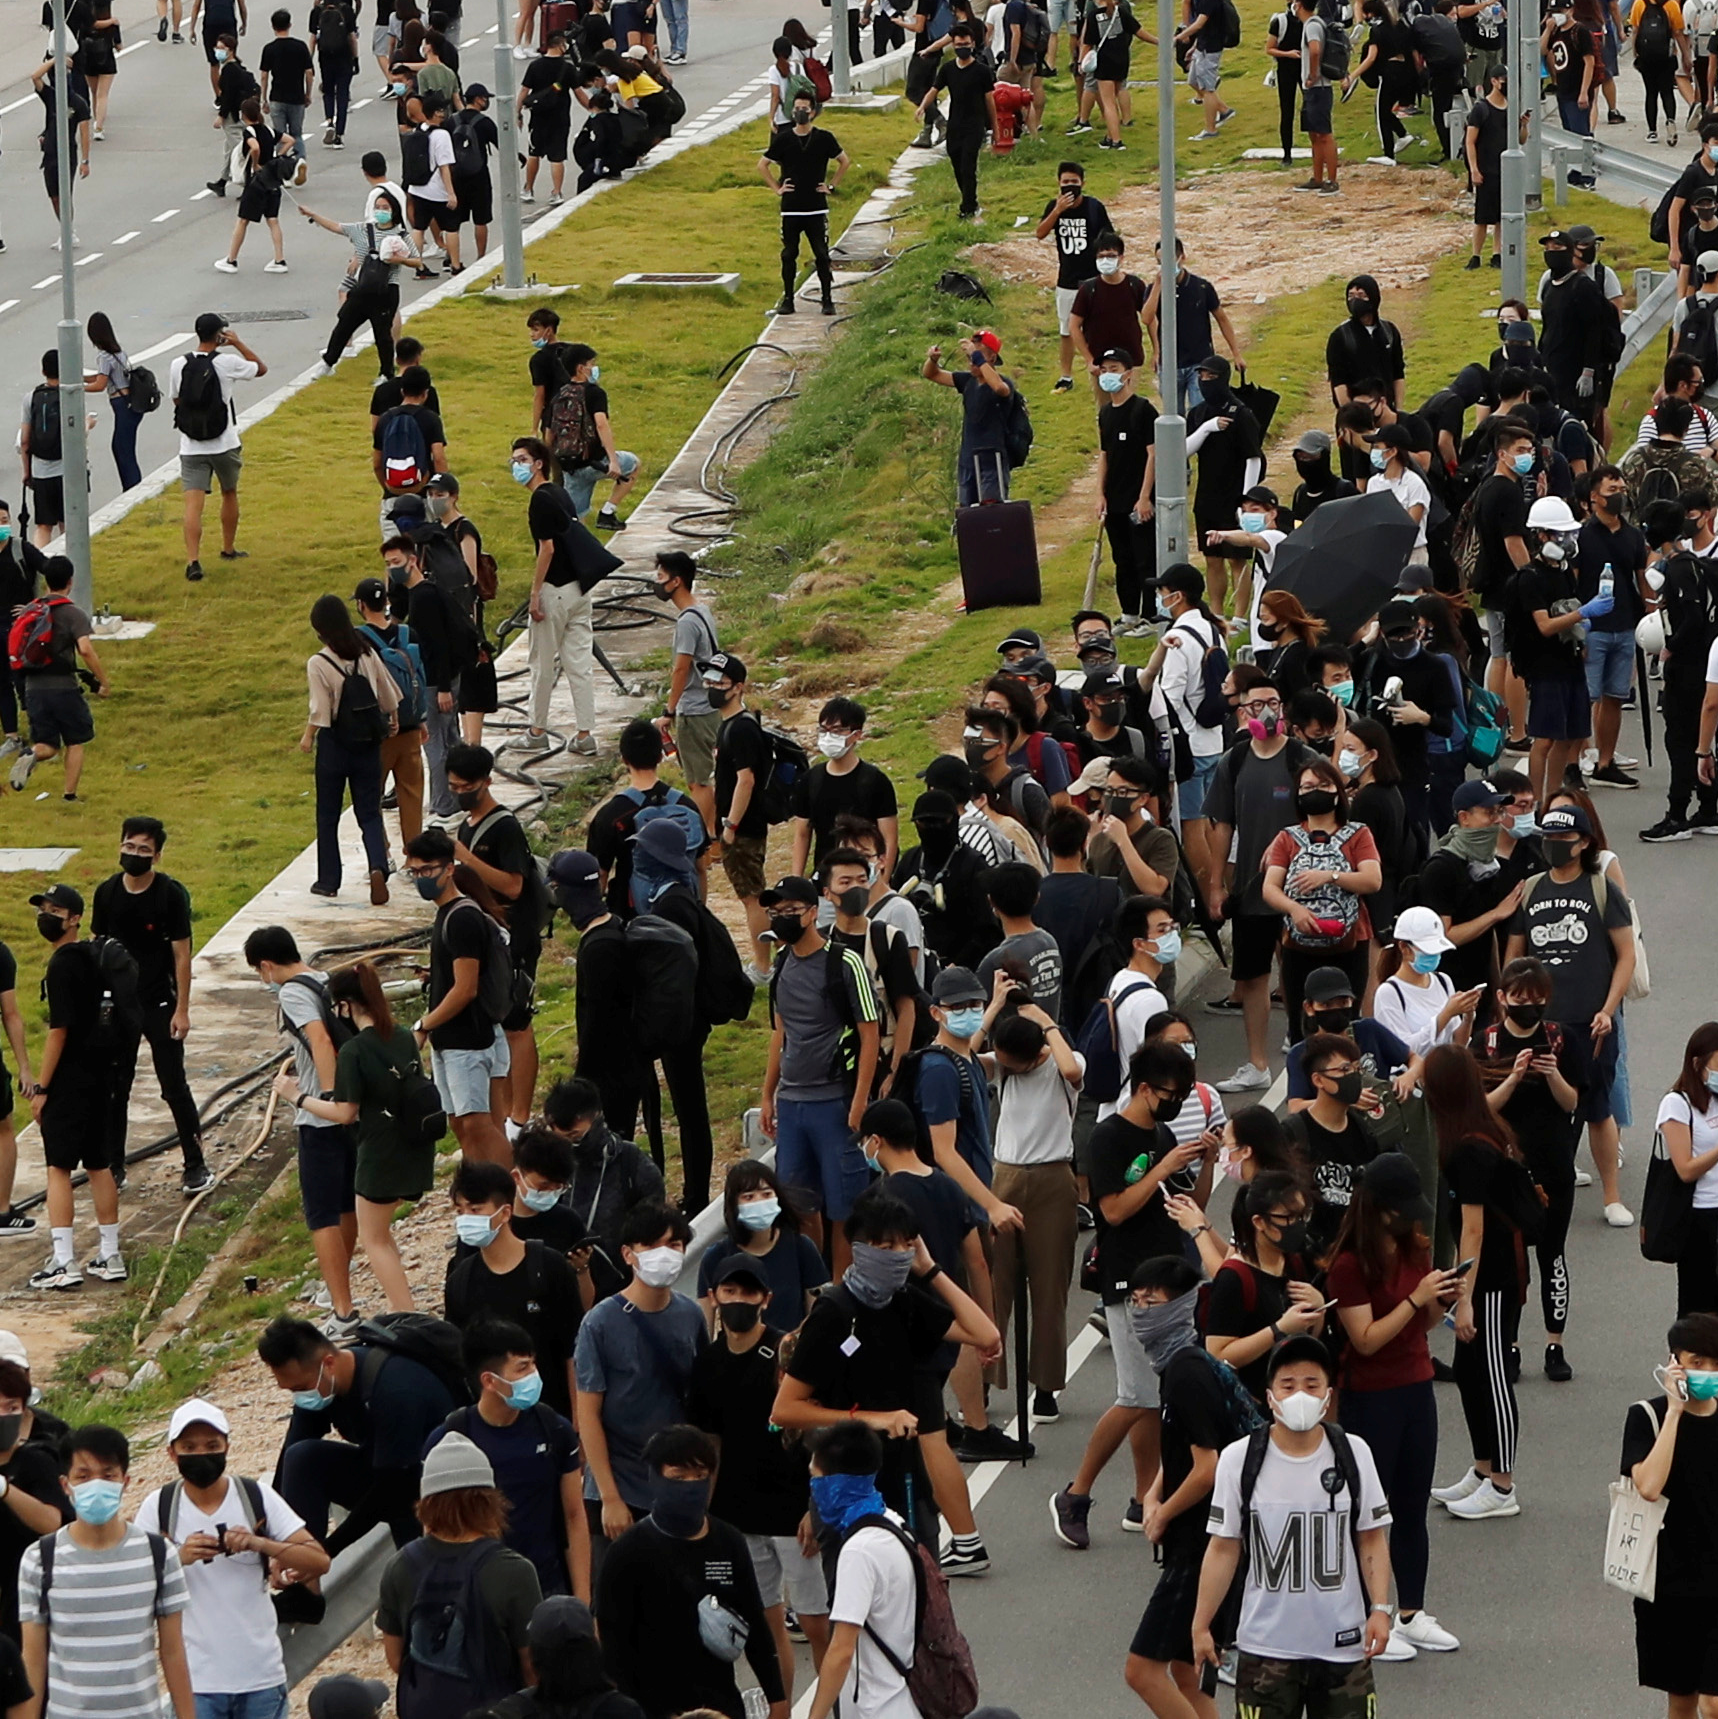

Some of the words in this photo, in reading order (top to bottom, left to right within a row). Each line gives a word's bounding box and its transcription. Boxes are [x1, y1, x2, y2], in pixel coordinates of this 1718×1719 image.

[1059, 218, 1086, 228] NEVER
[1059, 226, 1087, 237] GIVE
[1061, 237, 1087, 255] UP
[1529, 901, 1553, 916] BORN
[1554, 899, 1567, 907] TO
[1569, 899, 1592, 914] ROLL
[1551, 1254, 1567, 1321] adidas
[1619, 1534, 1638, 1549] ART
[1250, 1509, 1347, 1592] MU
